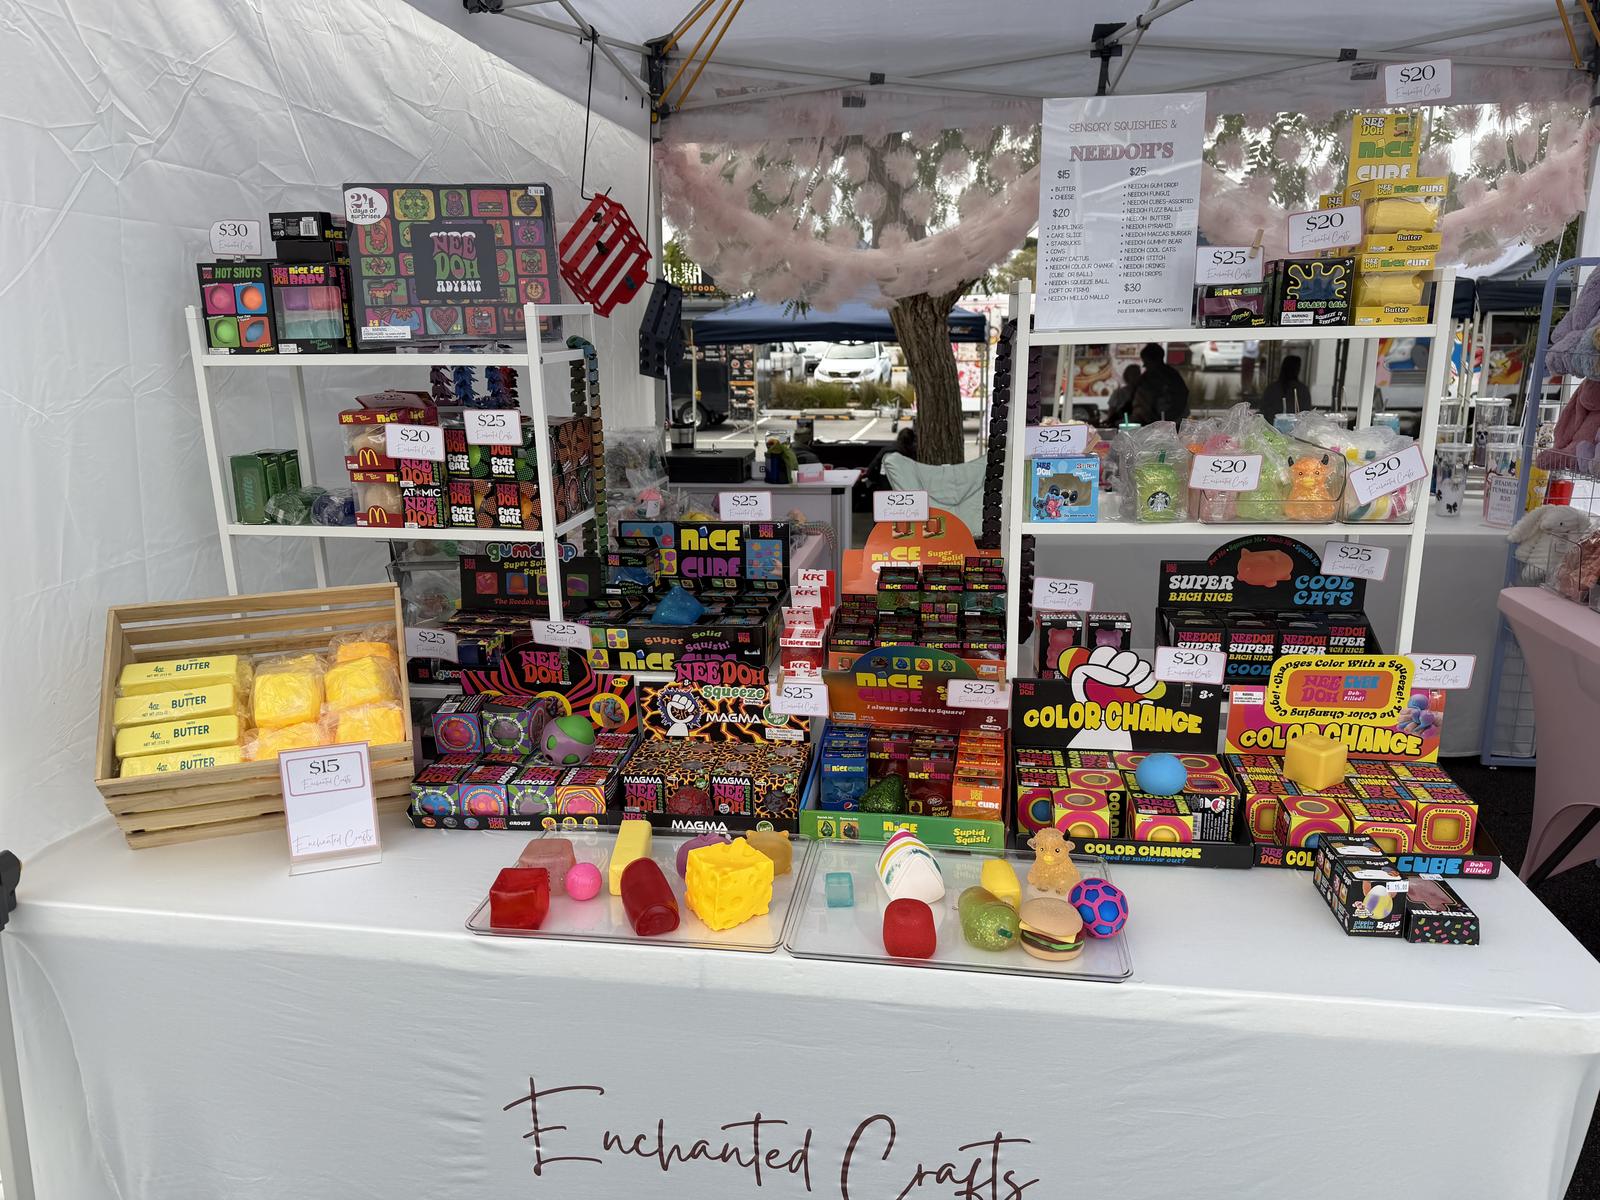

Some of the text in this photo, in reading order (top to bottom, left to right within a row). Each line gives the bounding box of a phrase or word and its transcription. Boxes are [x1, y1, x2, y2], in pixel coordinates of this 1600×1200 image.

[1400, 65, 1435, 84] $20
[1069, 120, 1177, 132] SENSORY SQUISHIES &
[1362, 117, 1385, 128] NEE
[1361, 126, 1384, 136] DOH
[1069, 142, 1174, 162] NEEDOH'S
[1057, 170, 1070, 180] $15
[1130, 166, 1147, 176] $25
[1356, 164, 1411, 180] CUBE
[350, 192, 376, 208] 24
[353, 208, 368, 216] days
[1052, 208, 1070, 218] $20
[1306, 213, 1344, 232] $20
[219, 224, 248, 237] $30
[1397, 233, 1422, 242] Butter
[430, 232, 476, 259] NEE
[1212, 250, 1246, 266] $25
[434, 252, 480, 280] DOH
[216, 268, 262, 278] HOT SHOTS
[290, 274, 324, 284] BABY
[436, 280, 482, 292] ADVENT
[1124, 283, 1141, 292] $30
[1384, 306, 1409, 314] Butter
[478, 414, 506, 428] $25
[400, 429, 430, 442] $20
[1038, 429, 1071, 444] $25
[448, 454, 468, 464] FUZZ
[492, 456, 514, 466] FUZZ
[448, 461, 470, 472] BALL
[492, 464, 515, 475] BALL
[1211, 459, 1247, 474] $20
[1364, 456, 1402, 482] $20
[404, 497, 436, 514] NEE
[732, 494, 758, 507] $25
[887, 494, 915, 508] $25
[486, 542, 577, 562] gumdp
[942, 554, 964, 562] Solid
[1338, 546, 1372, 562] $25
[681, 557, 741, 578] CUBE
[802, 574, 824, 582] KFC
[1169, 575, 1234, 590] SUPER
[1295, 575, 1354, 590] COOL
[1048, 582, 1078, 596] $25
[1207, 592, 1234, 602] NICE
[1293, 590, 1354, 606] CATS
[546, 624, 576, 635] $25
[692, 630, 722, 639] Solid
[418, 631, 446, 645] $25
[644, 636, 684, 646] Super
[1178, 632, 1222, 642] NEEDOH
[1232, 633, 1274, 644] NEEDOH
[1282, 634, 1327, 646] NEEDOH
[1330, 637, 1365, 646] UPER
[685, 640, 730, 652] Squish!
[1229, 644, 1274, 654] SUPER
[1280, 646, 1326, 655] SUPER
[519, 652, 562, 670] NEE
[1173, 652, 1208, 666] $20
[1314, 660, 1344, 668] Color
[1348, 660, 1376, 668] With
[1420, 658, 1457, 672] $20
[176, 662, 210, 672] BUTTER
[792, 662, 810, 670] KFC
[1274, 660, 1312, 685] Changes
[524, 664, 562, 684] DOH
[674, 662, 767, 686] NEE DOH
[1388, 660, 1408, 701] Squeeze!
[964, 684, 995, 695] $25
[1304, 675, 1342, 691] NEE
[702, 685, 766, 700] Squeeze
[784, 686, 813, 700] $25
[1199, 690, 1214, 700] 3+
[1302, 688, 1338, 702] DOH
[148, 696, 206, 710] 4oz BUTTER
[1270, 691, 1288, 717] Cube!
[872, 704, 898, 712] always
[936, 708, 966, 716] Square!
[1290, 708, 1378, 720] Color-Changing
[1380, 705, 1403, 719] The
[706, 713, 761, 724] MAGMA
[1024, 701, 1202, 734] COLOR CHANGE
[150, 725, 210, 740] 4oz BUTTER
[1323, 722, 1423, 756] CHANGE
[156, 757, 214, 772] 4oz BUTTER
[310, 758, 340, 776] $15
[624, 776, 662, 784] MAGMA
[712, 776, 750, 785] MAGMA
[672, 820, 728, 831] MAGMA
[293, 829, 374, 852] Enchanted Crafts
[956, 836, 990, 844] Squish!
[1084, 844, 1202, 859] COLOR CHANGE
[1262, 848, 1284, 858] NEE
[1260, 855, 1282, 864] DOH
[1286, 850, 1463, 874] COL CUBE
[1376, 921, 1400, 930] Eggs
[503, 1076, 1040, 1200] Enchanted Crafts
